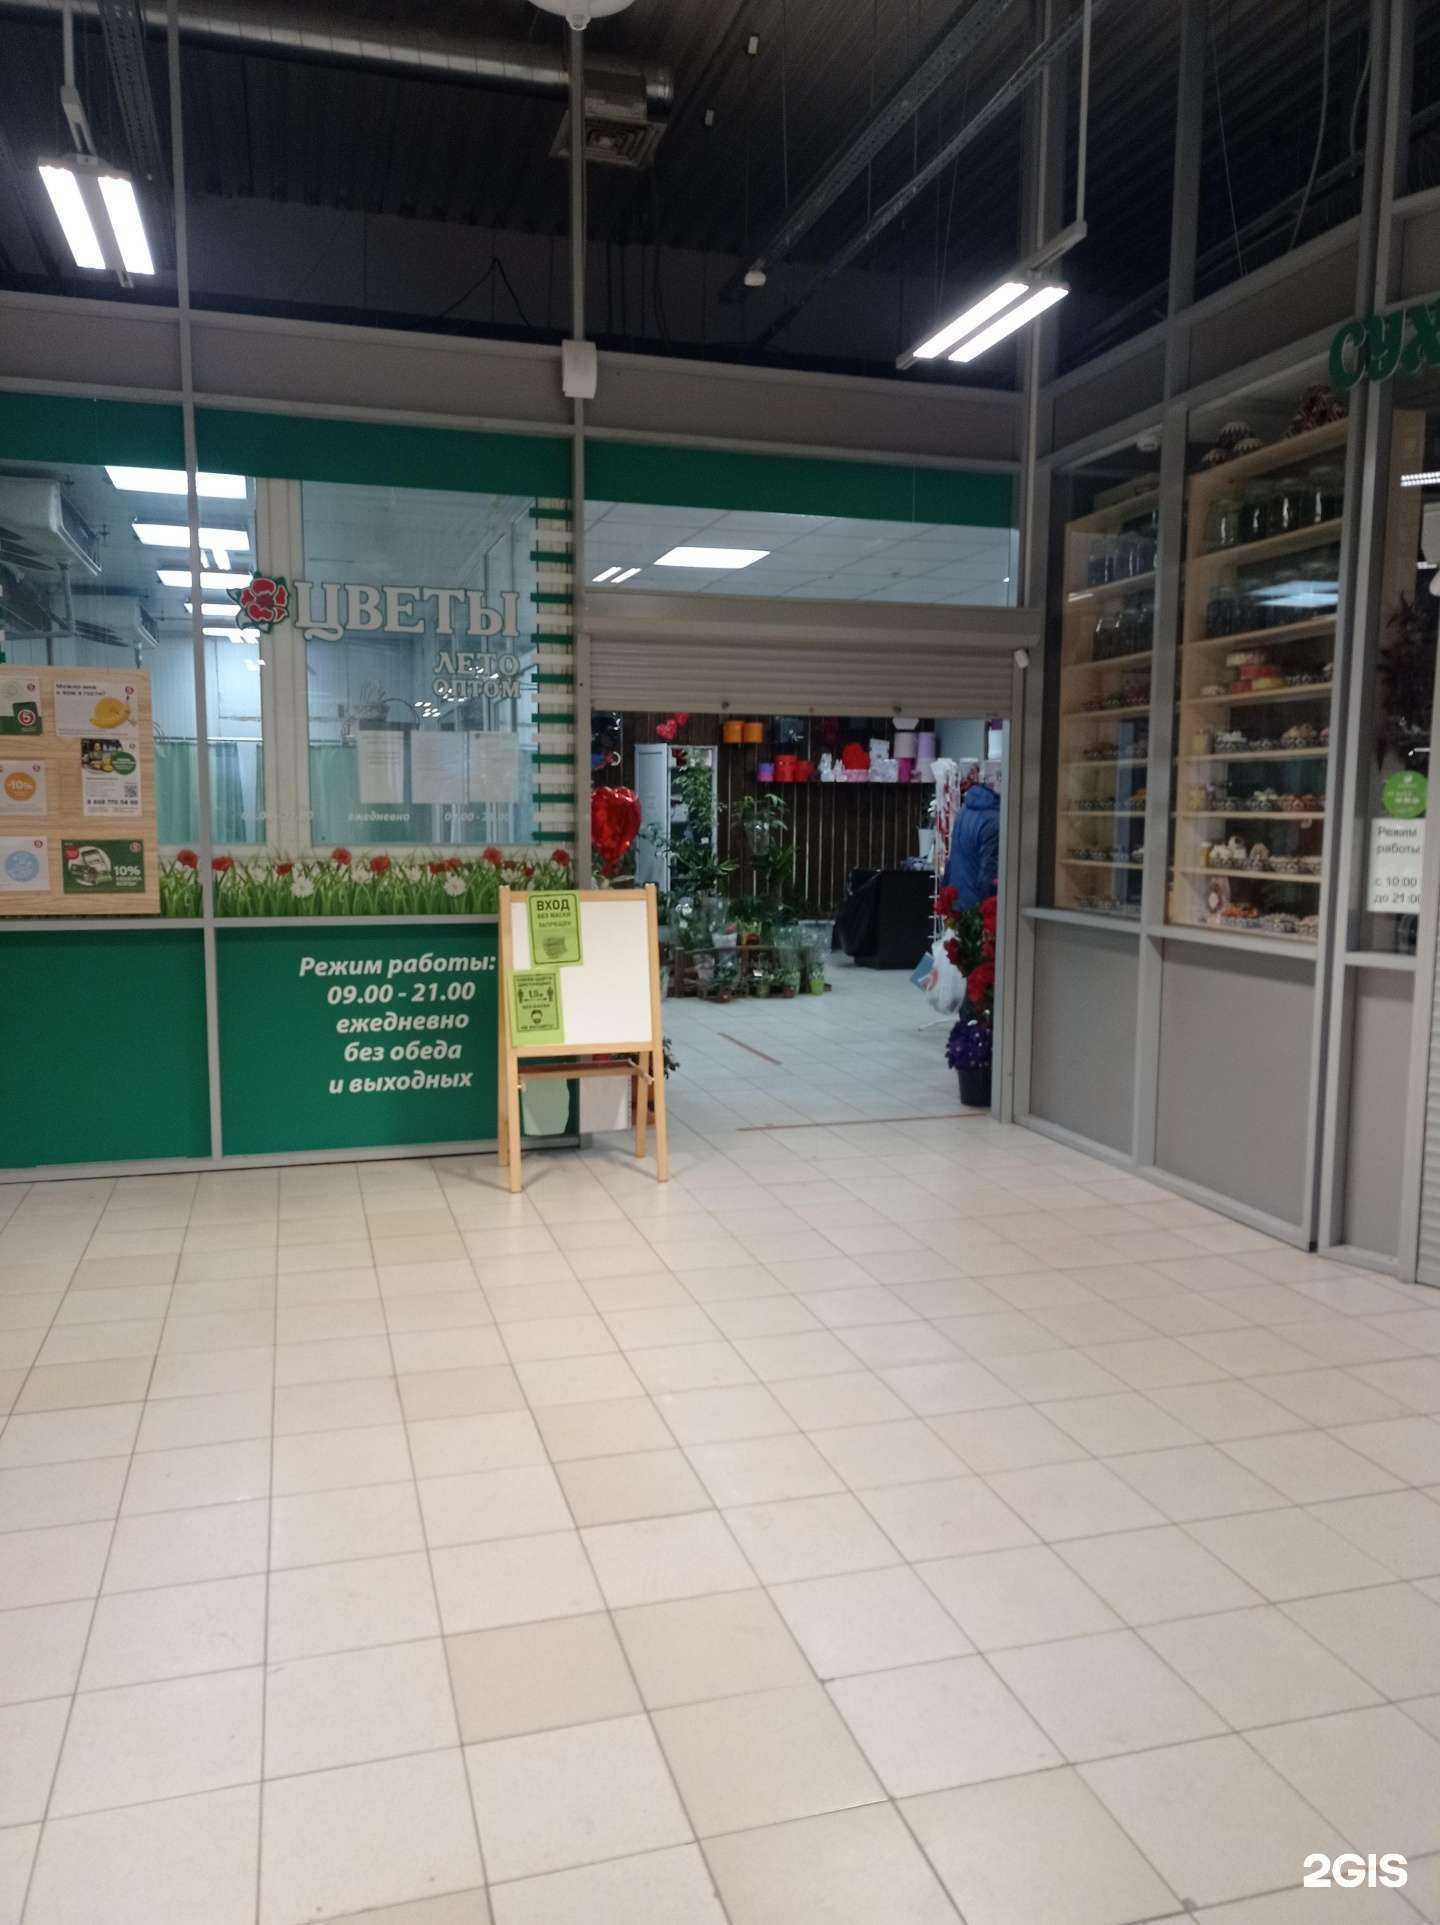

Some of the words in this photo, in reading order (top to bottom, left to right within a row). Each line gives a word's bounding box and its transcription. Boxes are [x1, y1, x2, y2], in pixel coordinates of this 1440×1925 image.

[293, 581, 520, 642] ЦВЕТЫ
[433, 652, 520, 677] ЛЕТО
[432, 678, 521, 700] ОПТОМ
[536, 899, 570, 911] ВХОД
[299, 957, 382, 976] Режим
[387, 953, 496, 978] работы:
[327, 984, 393, 1004] 09.00
[411, 982, 476, 1002] 21.00
[336, 1012, 469, 1033] ежедневно
[344, 1042, 384, 1062] без
[390, 1040, 462, 1060] обеда
[329, 1079, 343, 1094] и
[349, 1070, 473, 1093] выходных
